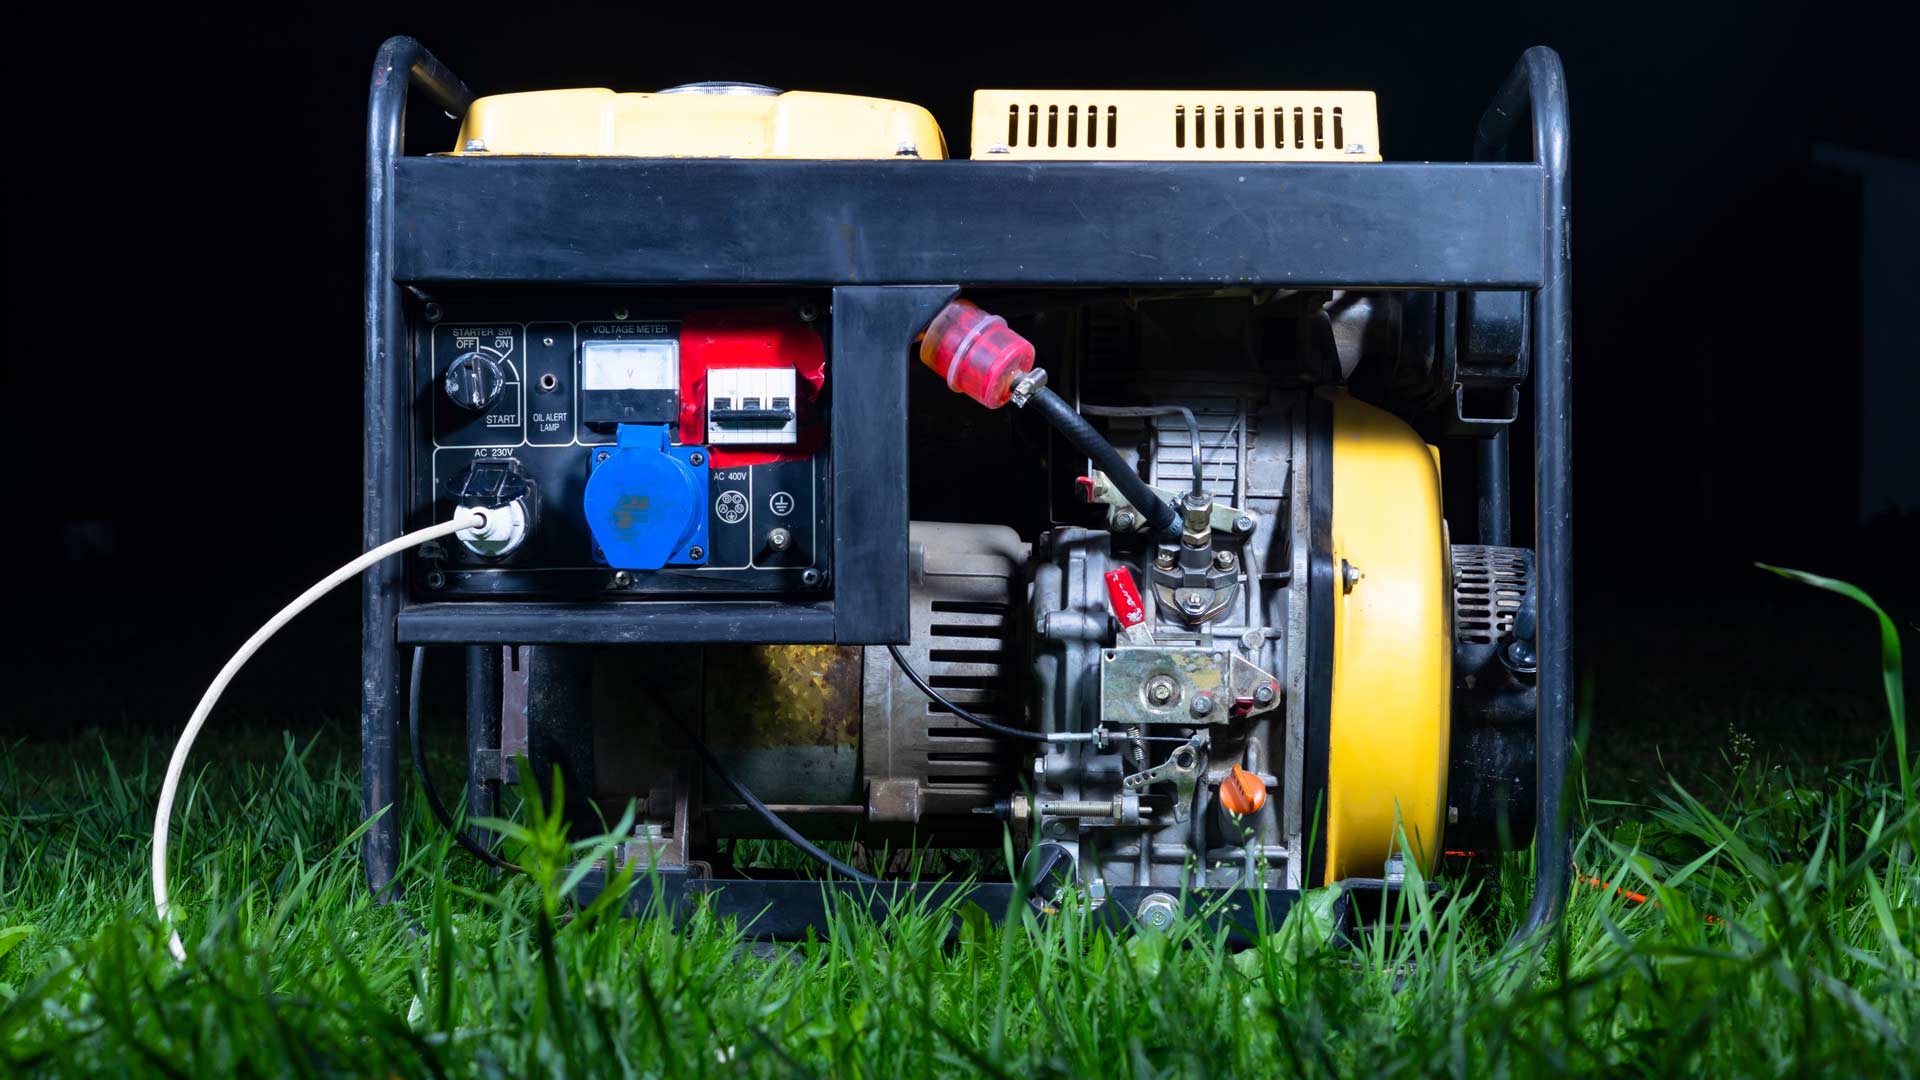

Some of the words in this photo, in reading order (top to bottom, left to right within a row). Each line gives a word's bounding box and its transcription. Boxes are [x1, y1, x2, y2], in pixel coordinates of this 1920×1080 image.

[453, 328, 493, 337] STARTER
[497, 328, 512, 336] SW
[592, 325, 635, 334] VOLTAGE
[636, 325, 669, 333] METER
[456, 340, 475, 349] OFF
[495, 340, 509, 348] ON
[627, 368, 633, 378] V
[486, 415, 516, 424] START
[533, 413, 545, 422] OIL
[546, 412, 567, 421] ALERT
[540, 423, 560, 432] LAMP
[474, 448, 487, 457] AC
[491, 447, 513, 457] 230V
[713, 472, 725, 481] AC
[728, 471, 747, 481] 400V
